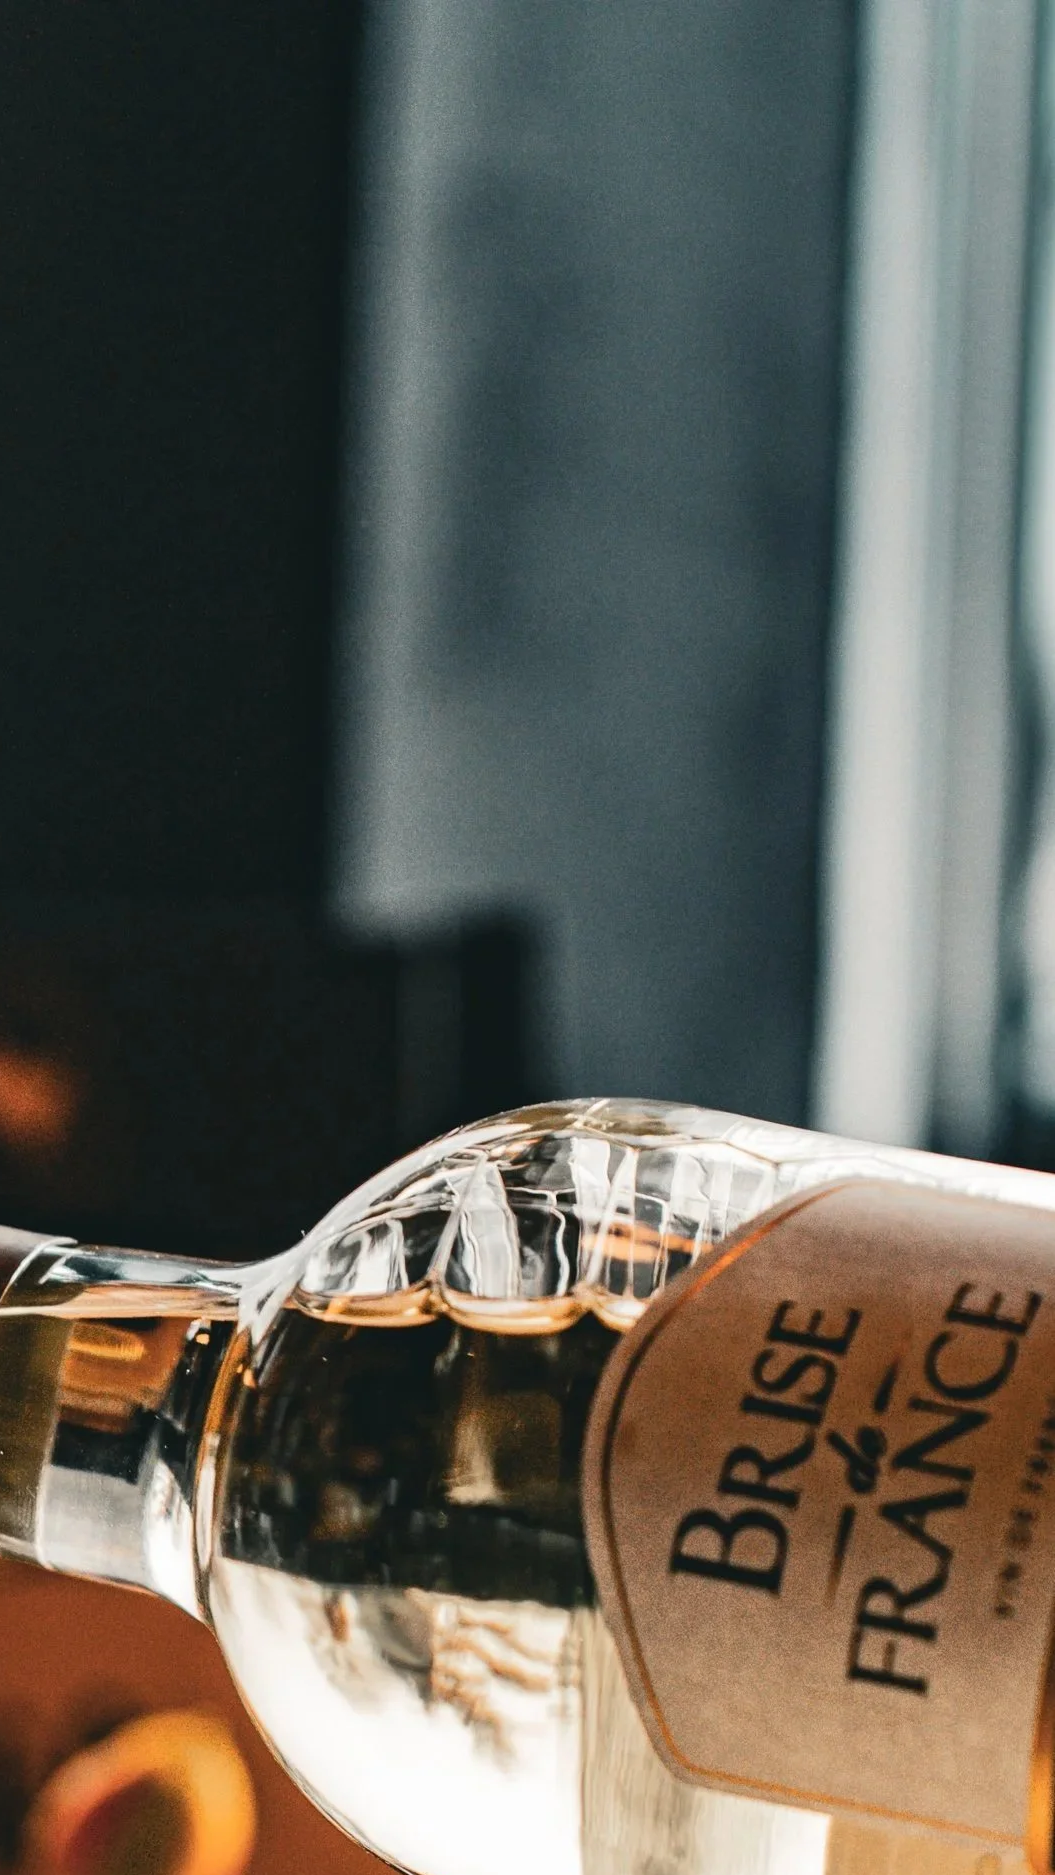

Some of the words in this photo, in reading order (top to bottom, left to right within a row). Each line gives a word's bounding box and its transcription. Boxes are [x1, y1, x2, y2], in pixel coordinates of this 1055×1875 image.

[668, 1300, 861, 1597] BRISE
[825, 1424, 888, 1494] de
[846, 1281, 1042, 1697] FRANCE
